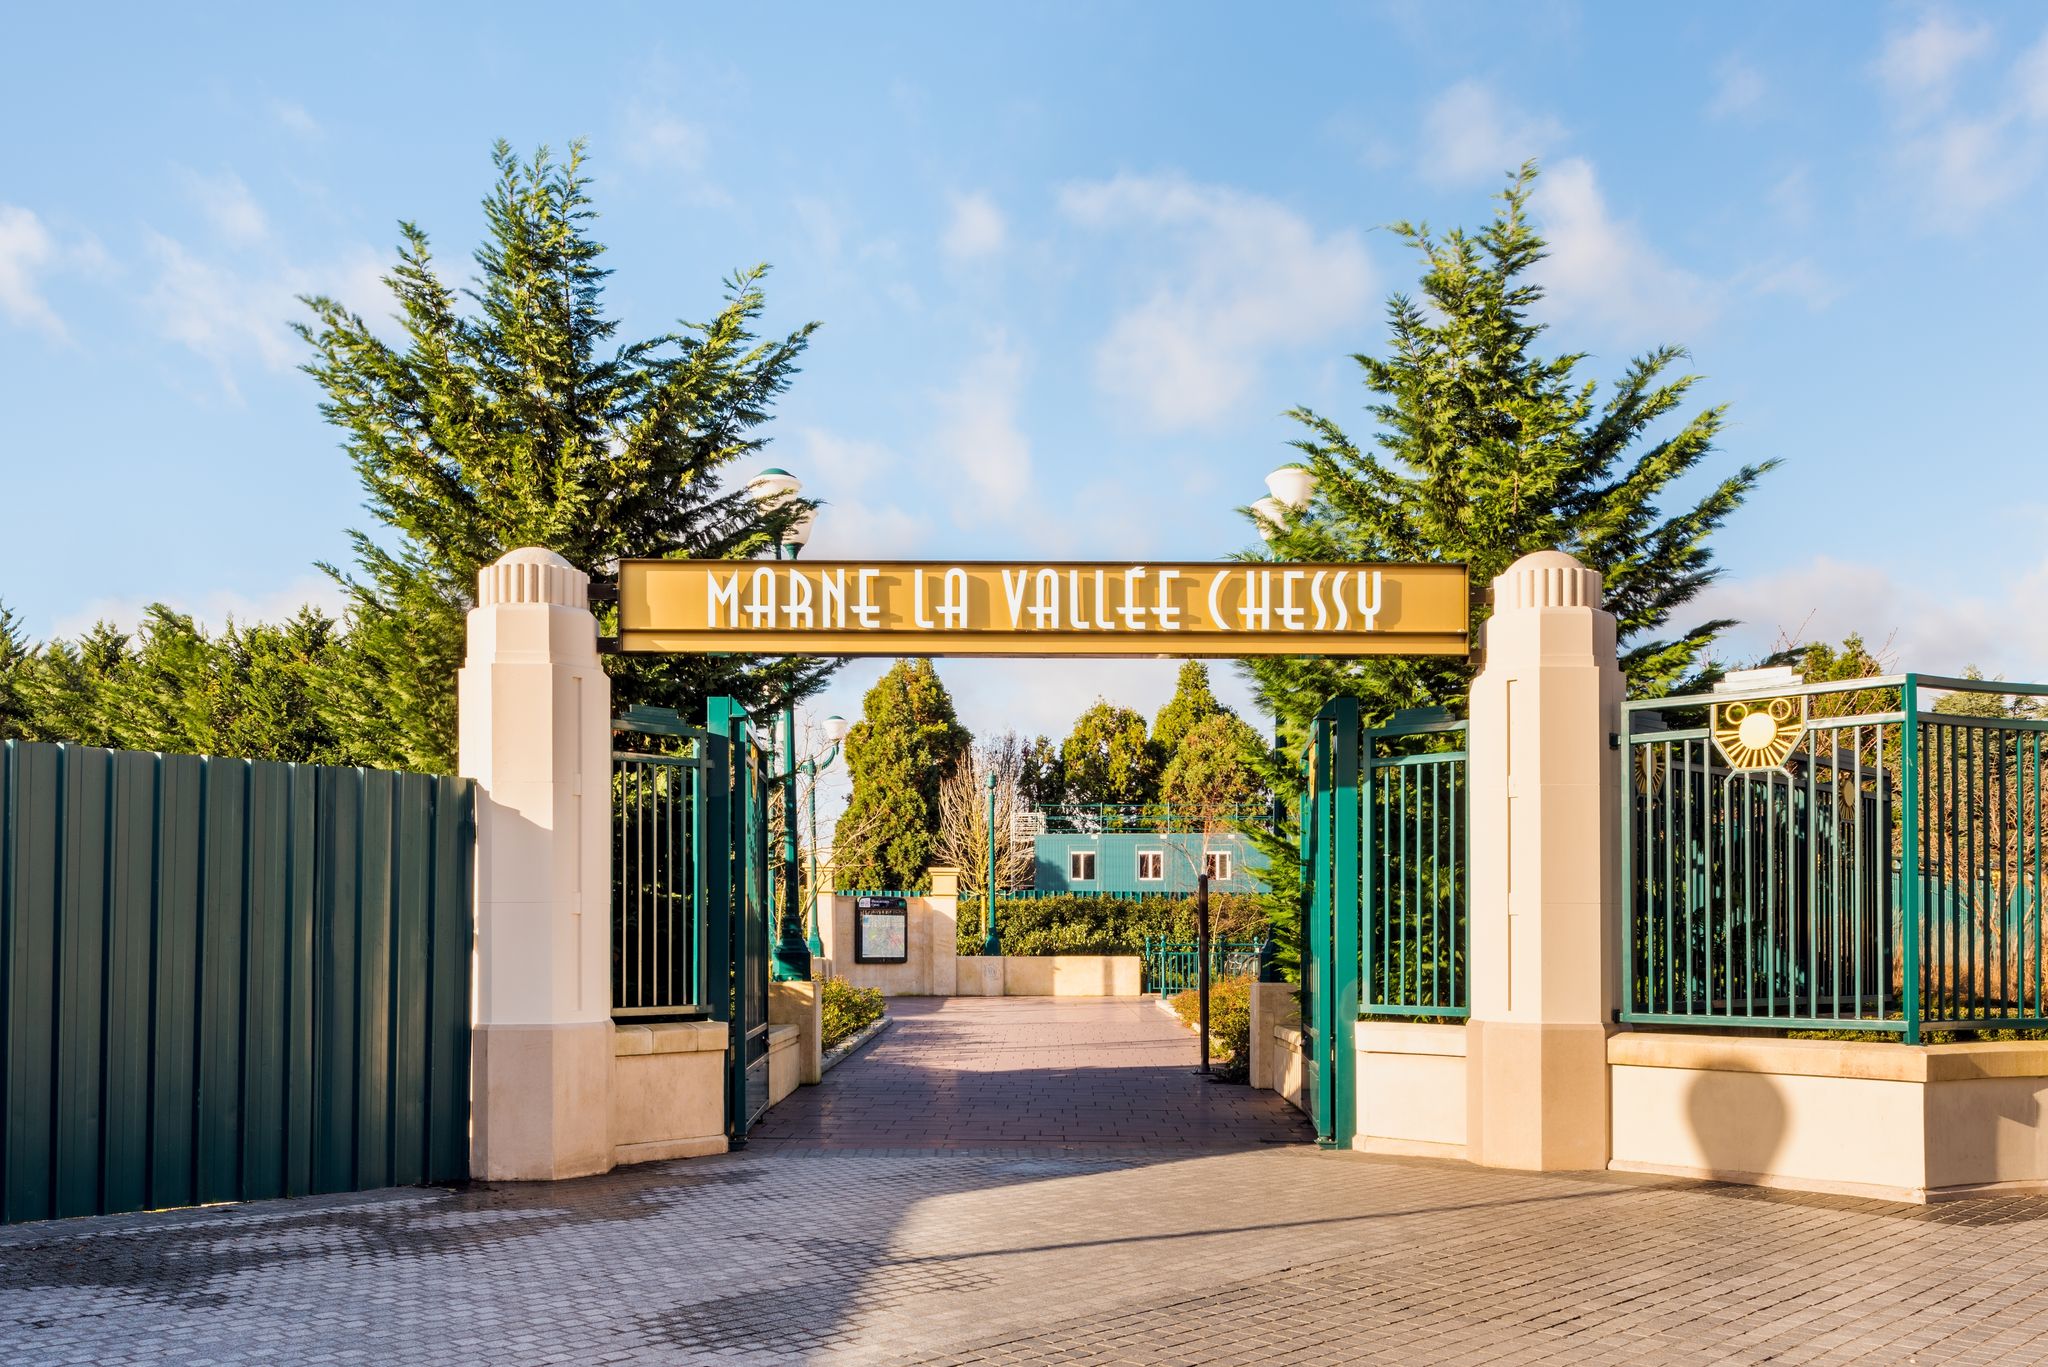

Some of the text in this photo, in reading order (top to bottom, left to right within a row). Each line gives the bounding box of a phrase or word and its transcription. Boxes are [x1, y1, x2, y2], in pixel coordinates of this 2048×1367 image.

[707, 566, 1382, 631] MARNE LA VALLÉE CHESSY
